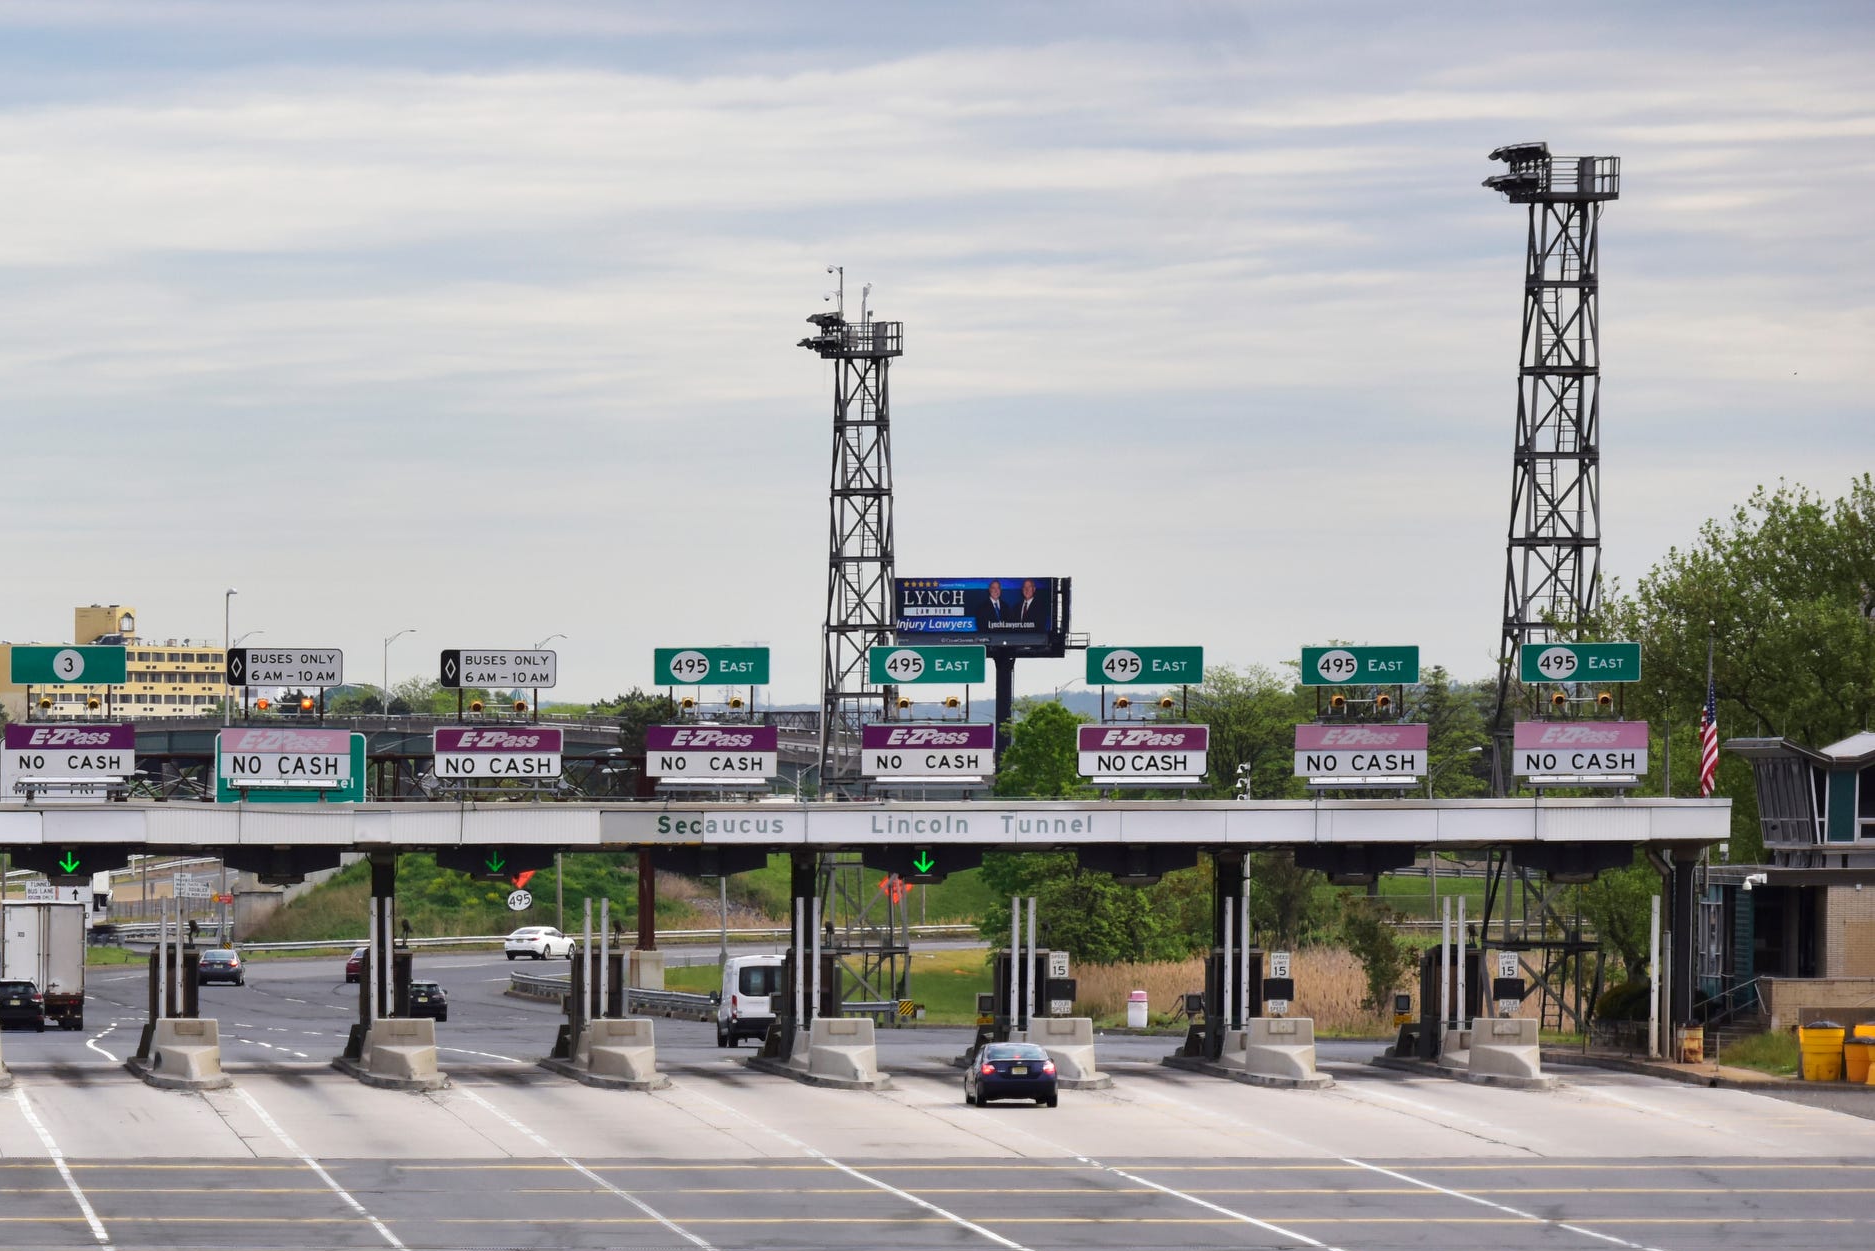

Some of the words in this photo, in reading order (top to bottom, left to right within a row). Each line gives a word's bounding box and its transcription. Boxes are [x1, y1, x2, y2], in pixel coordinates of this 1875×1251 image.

[903, 590, 965, 605] LYNCH
[896, 619, 926, 632] Injury
[929, 619, 973, 632] Lawyers
[988, 620, 1035, 630] LynchLawyers.com
[64, 658, 73, 672] 3
[251, 654, 293, 664] BUSES
[301, 654, 335, 664] ONLY
[465, 656, 507, 665] BUSES
[514, 656, 549, 665] ONLY
[673, 659, 707, 673] 495
[720, 660, 754, 672] EAST
[888, 658, 922, 672] 495
[935, 659, 969, 671] EAST
[1105, 658, 1139, 672] 495
[1153, 660, 1187, 671] EAST
[1320, 659, 1355, 673] 495
[1369, 660, 1403, 671] EAST
[1540, 656, 1575, 670] 495
[1589, 657, 1623, 668] EAST
[251, 671, 260, 680] 6
[263, 671, 282, 681] AM
[298, 671, 313, 681] 10
[316, 672, 335, 681] AM
[465, 672, 474, 682] 6
[477, 673, 496, 682] AM
[513, 672, 526, 683] 10
[530, 673, 549, 682] AM
[20, 756, 44, 769] NO
[68, 756, 120, 769] CASH
[233, 756, 261, 774] NO
[278, 757, 337, 775] CASH
[446, 758, 474, 773] NO
[490, 758, 550, 773] CASH
[661, 757, 686, 770] NO
[710, 757, 762, 771] CASH
[877, 756, 902, 769] NO
[926, 755, 978, 768] CASH
[1098, 755, 1125, 771] NO
[1132, 755, 1186, 771] CASH
[1307, 755, 1336, 771] NO
[1352, 755, 1414, 770] CASH
[1527, 754, 1556, 770] NO
[1572, 753, 1634, 769] CASH
[658, 815, 784, 835] Secaucus
[872, 815, 968, 833] Lincoln
[1001, 815, 1092, 833] Tunnel
[509, 894, 531, 906] 495
[1053, 966, 1066, 975] 15
[1274, 966, 1287, 976] 15
[1502, 966, 1515, 976] 15
